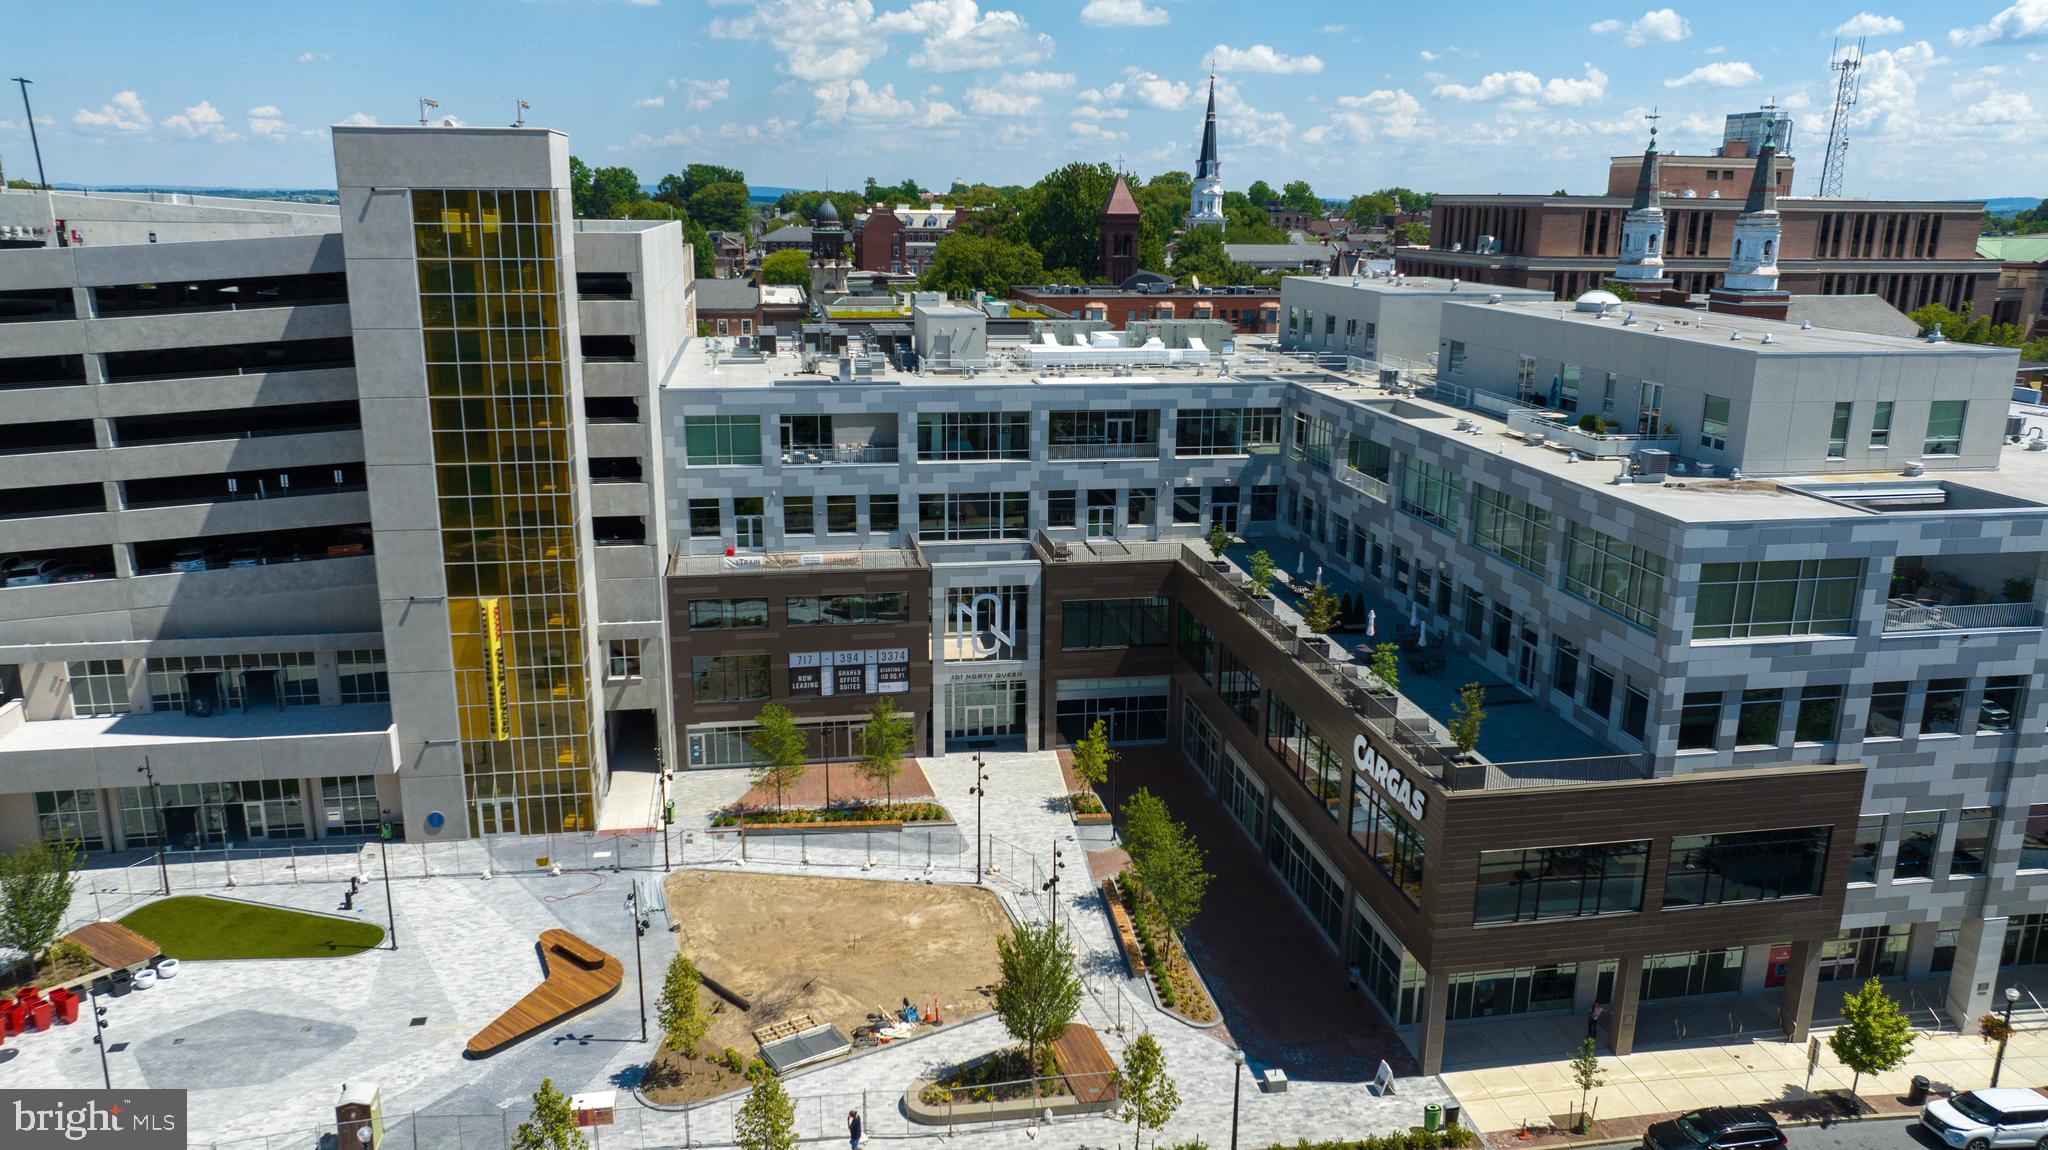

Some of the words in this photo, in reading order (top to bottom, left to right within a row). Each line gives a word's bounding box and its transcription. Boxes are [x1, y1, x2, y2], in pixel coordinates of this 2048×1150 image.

[797, 655, 813, 665] 717
[840, 652, 859, 663] 394
[881, 651, 905, 662] 3374
[838, 669, 862, 677] SHARED
[792, 682, 819, 690] LEASING
[1353, 734, 1425, 820] CARGAS
